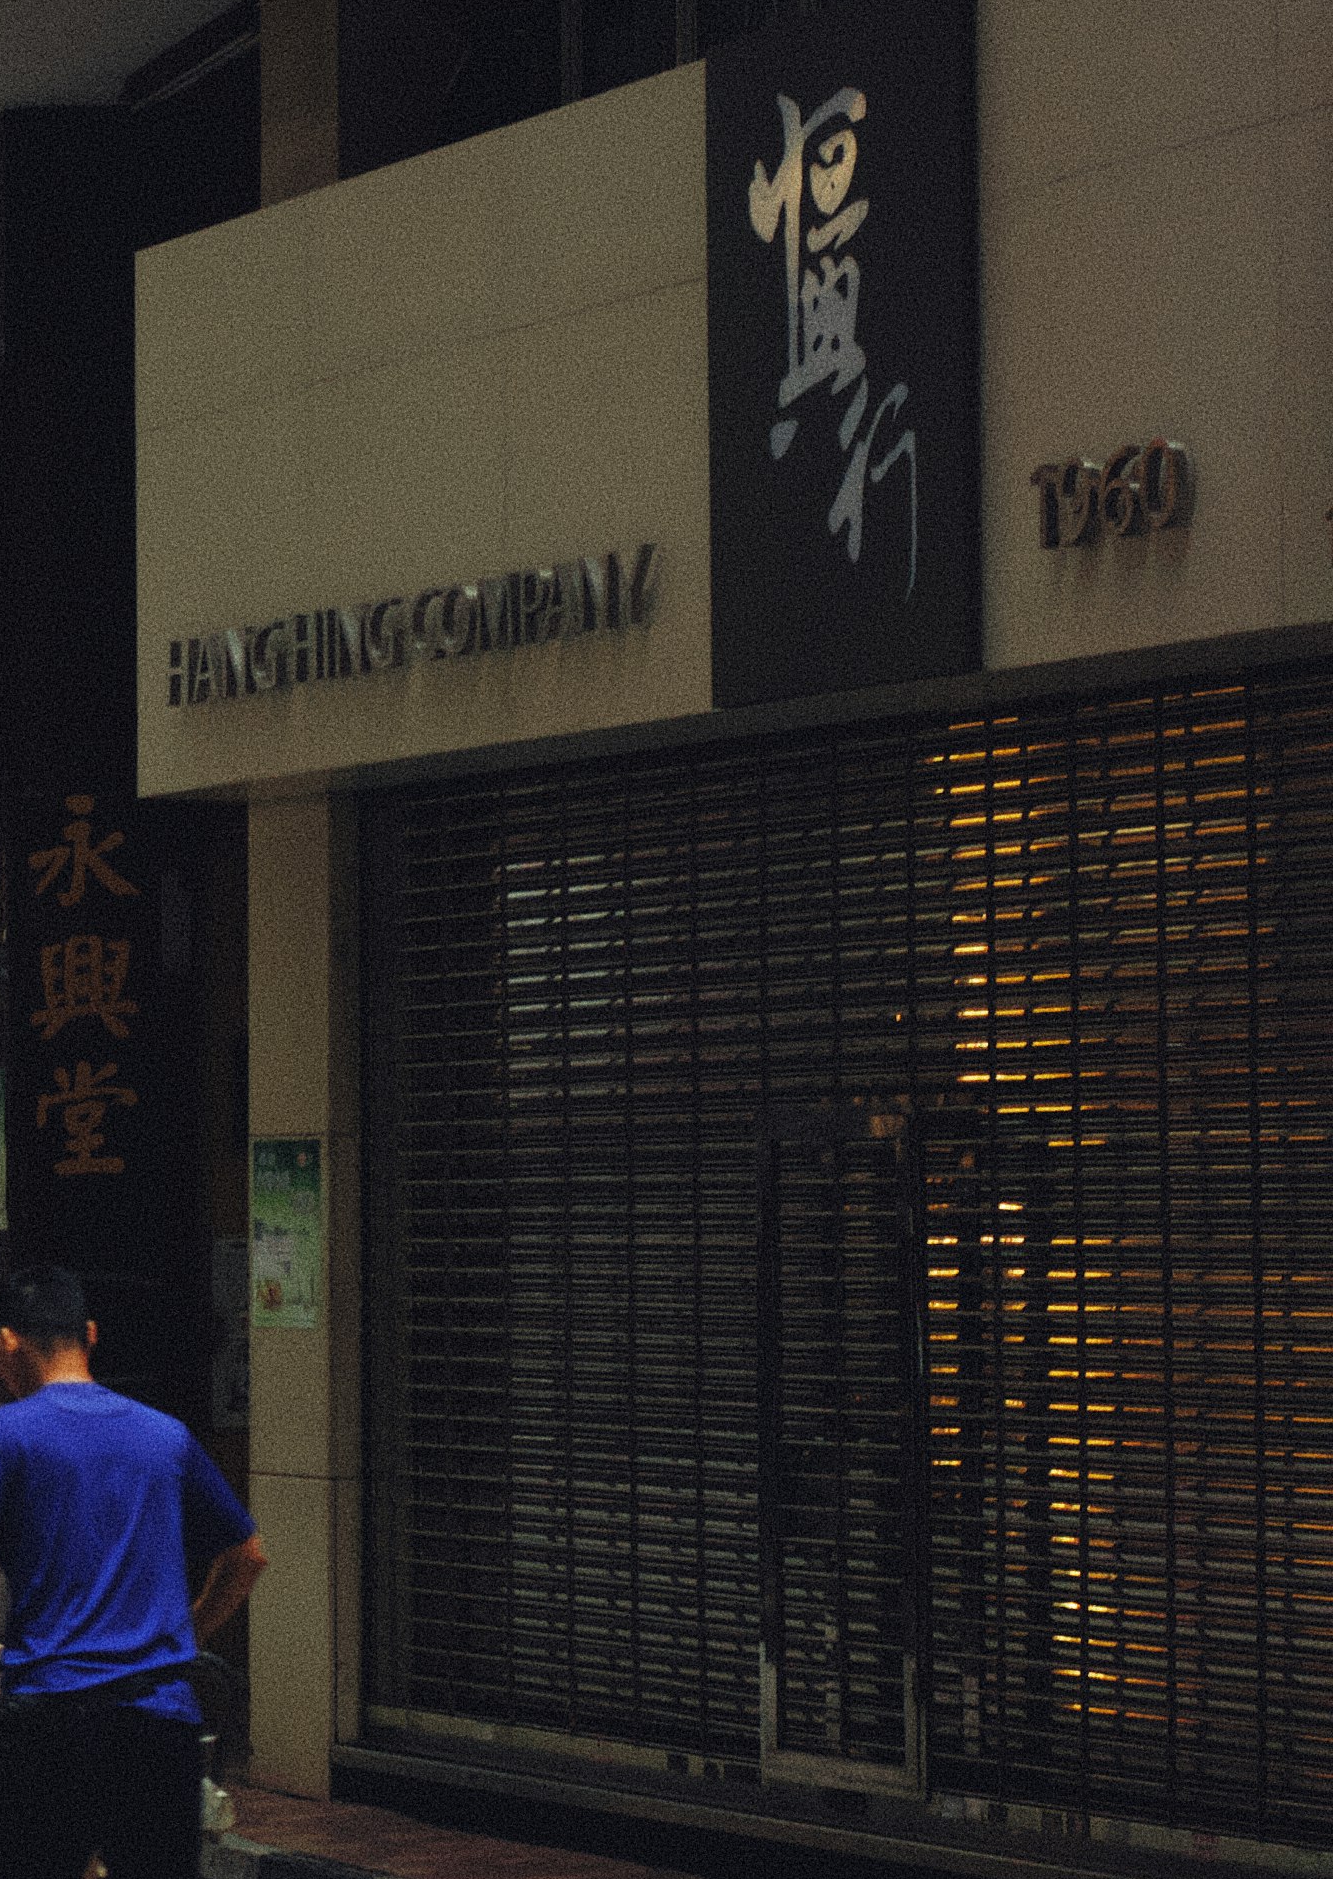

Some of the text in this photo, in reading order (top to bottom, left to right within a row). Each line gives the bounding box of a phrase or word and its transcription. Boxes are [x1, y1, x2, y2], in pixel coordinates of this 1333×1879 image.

[1030, 435, 1198, 550] 1960
[168, 542, 661, 707] HANG HING COMPANY
[28, 793, 141, 1176] 永興堂
